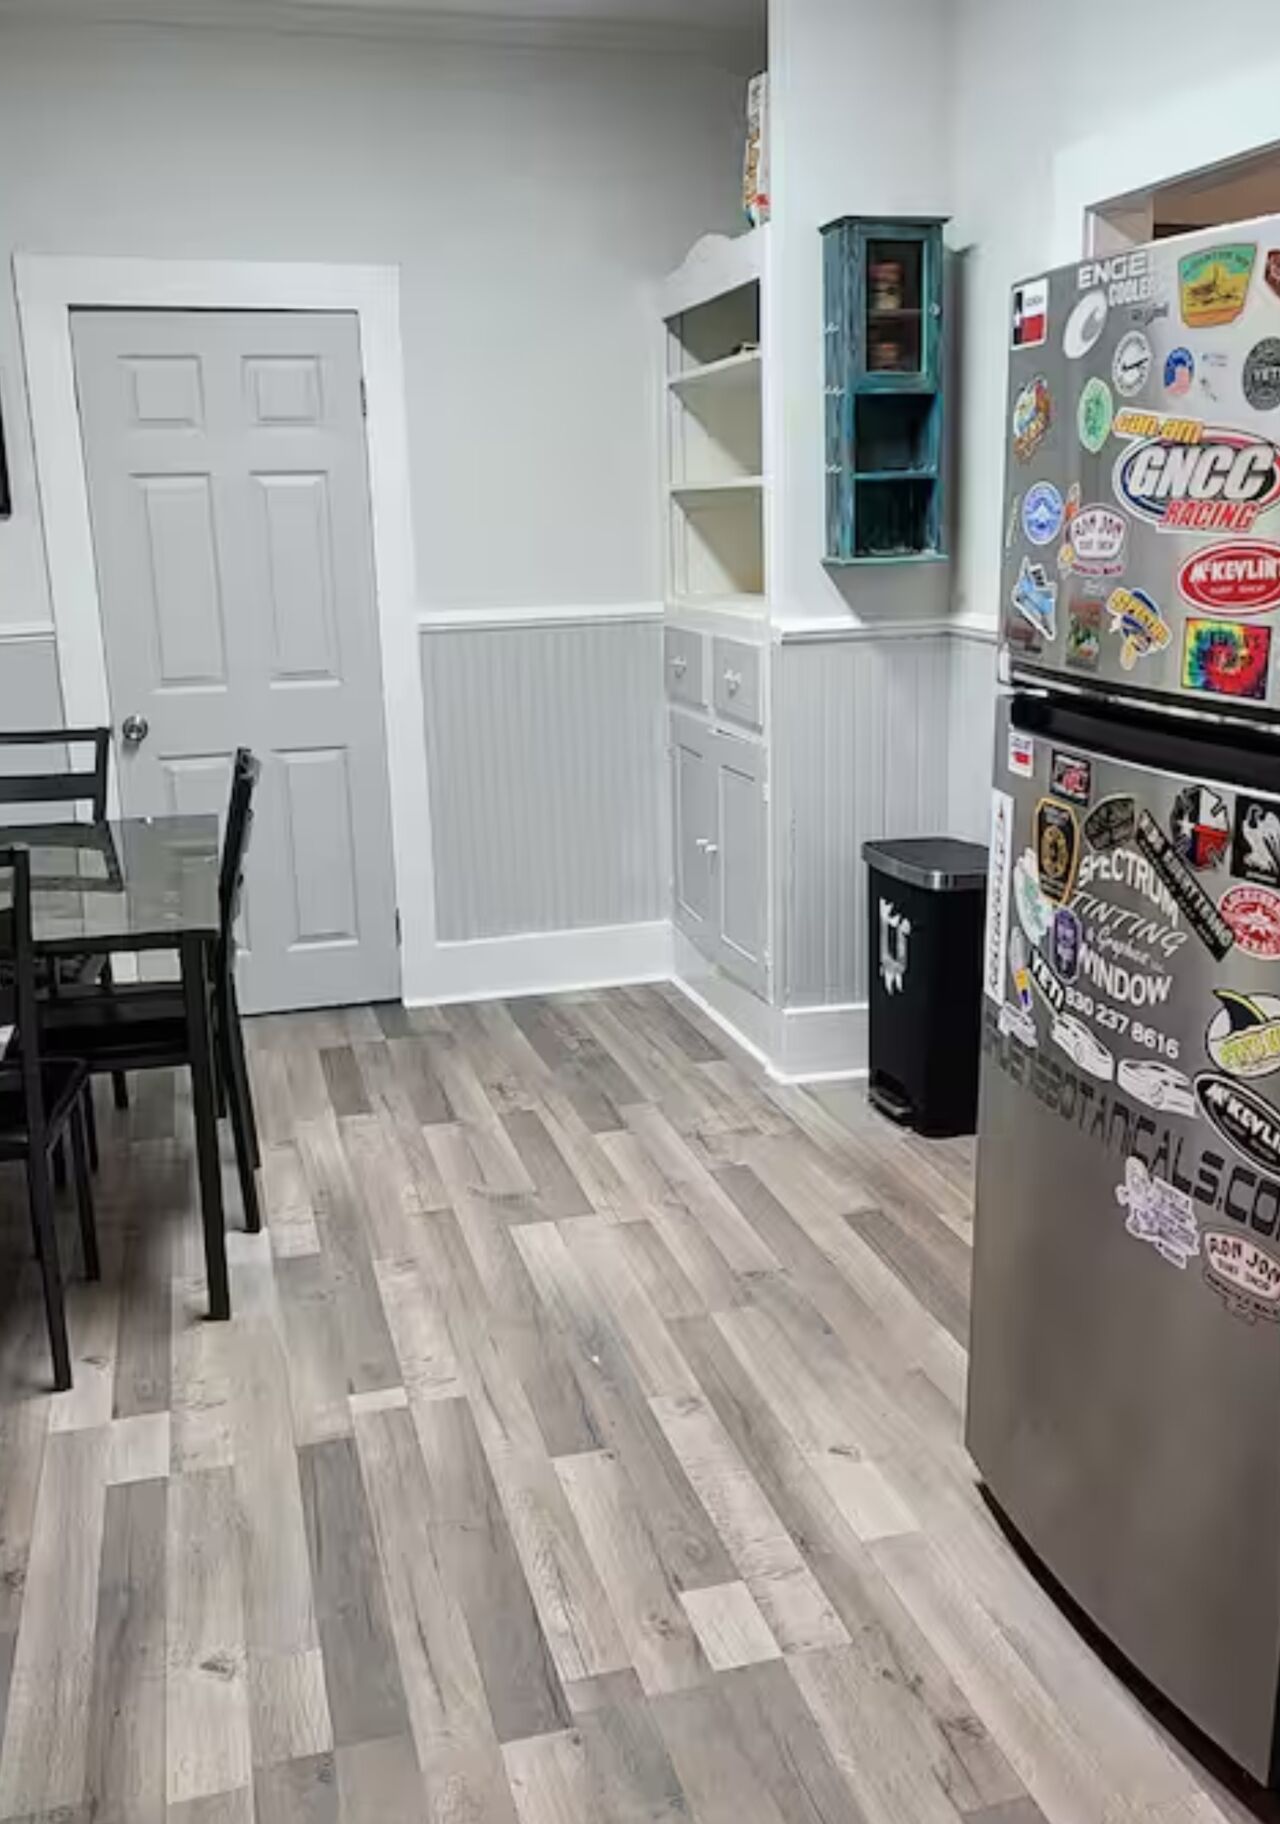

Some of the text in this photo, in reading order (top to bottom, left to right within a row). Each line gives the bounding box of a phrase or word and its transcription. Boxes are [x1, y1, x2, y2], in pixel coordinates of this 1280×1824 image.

[1125, 443, 1277, 500] GNCC
[1157, 500, 1263, 531] RACING
[1078, 847, 1180, 929] SPECTRUM
[1070, 890, 1189, 958] TINTING
[1032, 950, 1064, 1013] YETI
[1095, 1003, 1130, 1034] 237
[1131, 1021, 1180, 1060] 8616
